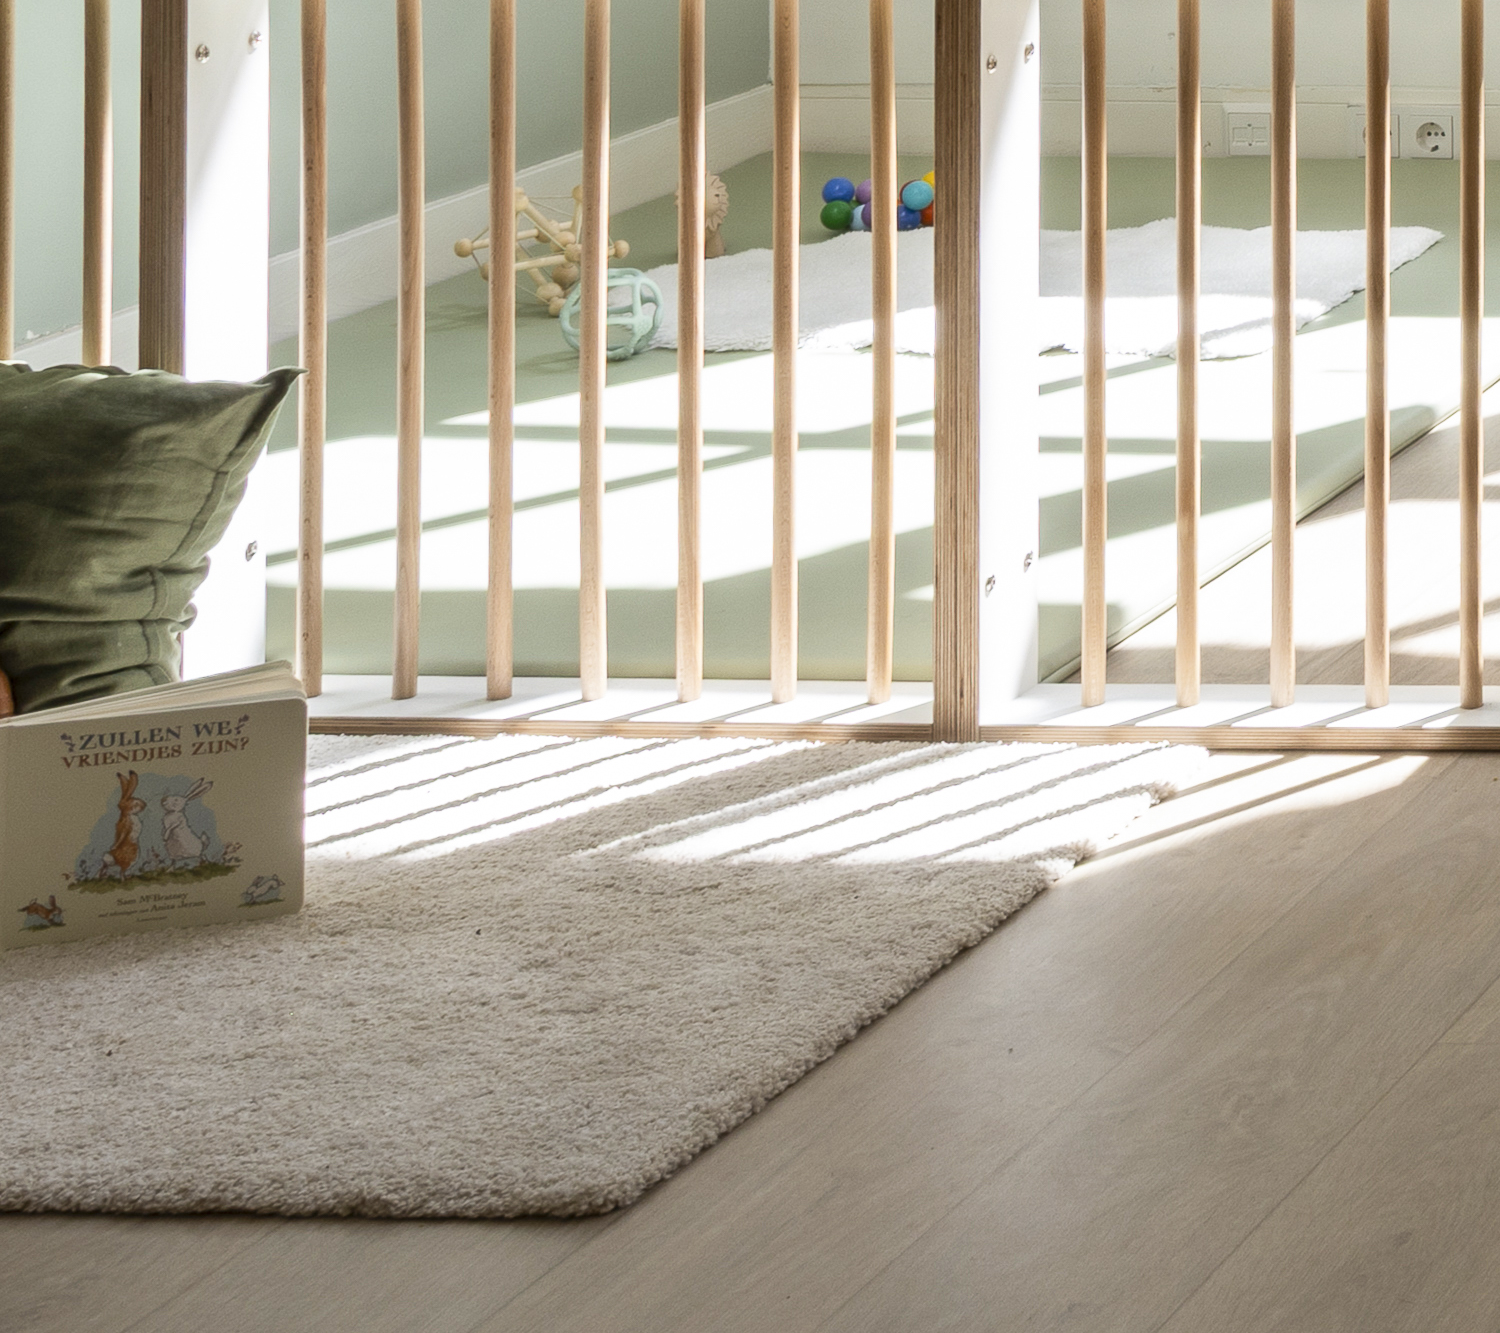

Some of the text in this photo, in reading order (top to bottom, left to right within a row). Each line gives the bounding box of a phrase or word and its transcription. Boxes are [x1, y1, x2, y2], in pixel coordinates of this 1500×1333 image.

[79, 720, 232, 751] ZULLEN WE
[61, 737, 250, 769] VRIENDJES ZIJN?
